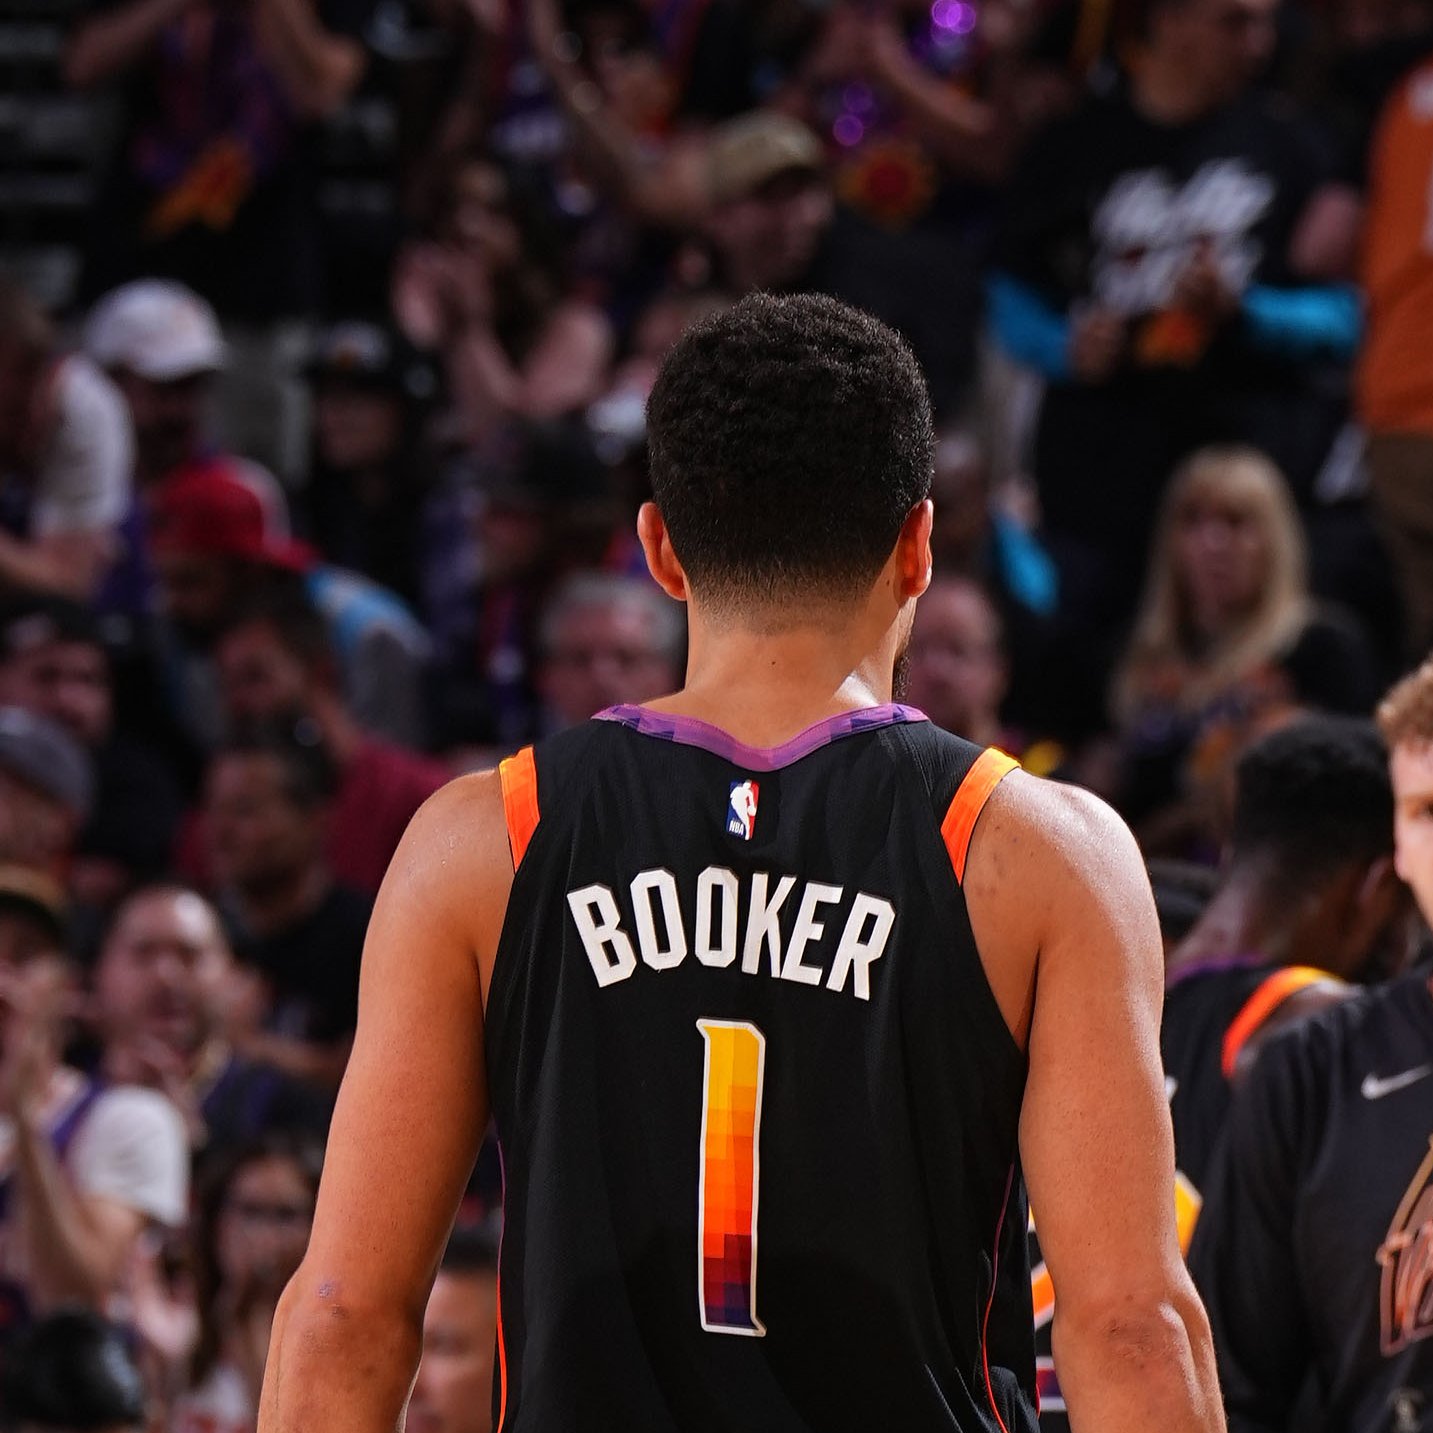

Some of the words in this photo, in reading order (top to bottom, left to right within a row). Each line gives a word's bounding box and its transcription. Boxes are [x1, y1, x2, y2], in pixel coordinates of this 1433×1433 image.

[729, 819, 745, 836] NBA
[566, 865, 897, 1002] BOOKER
[695, 1017, 767, 1338] 1
